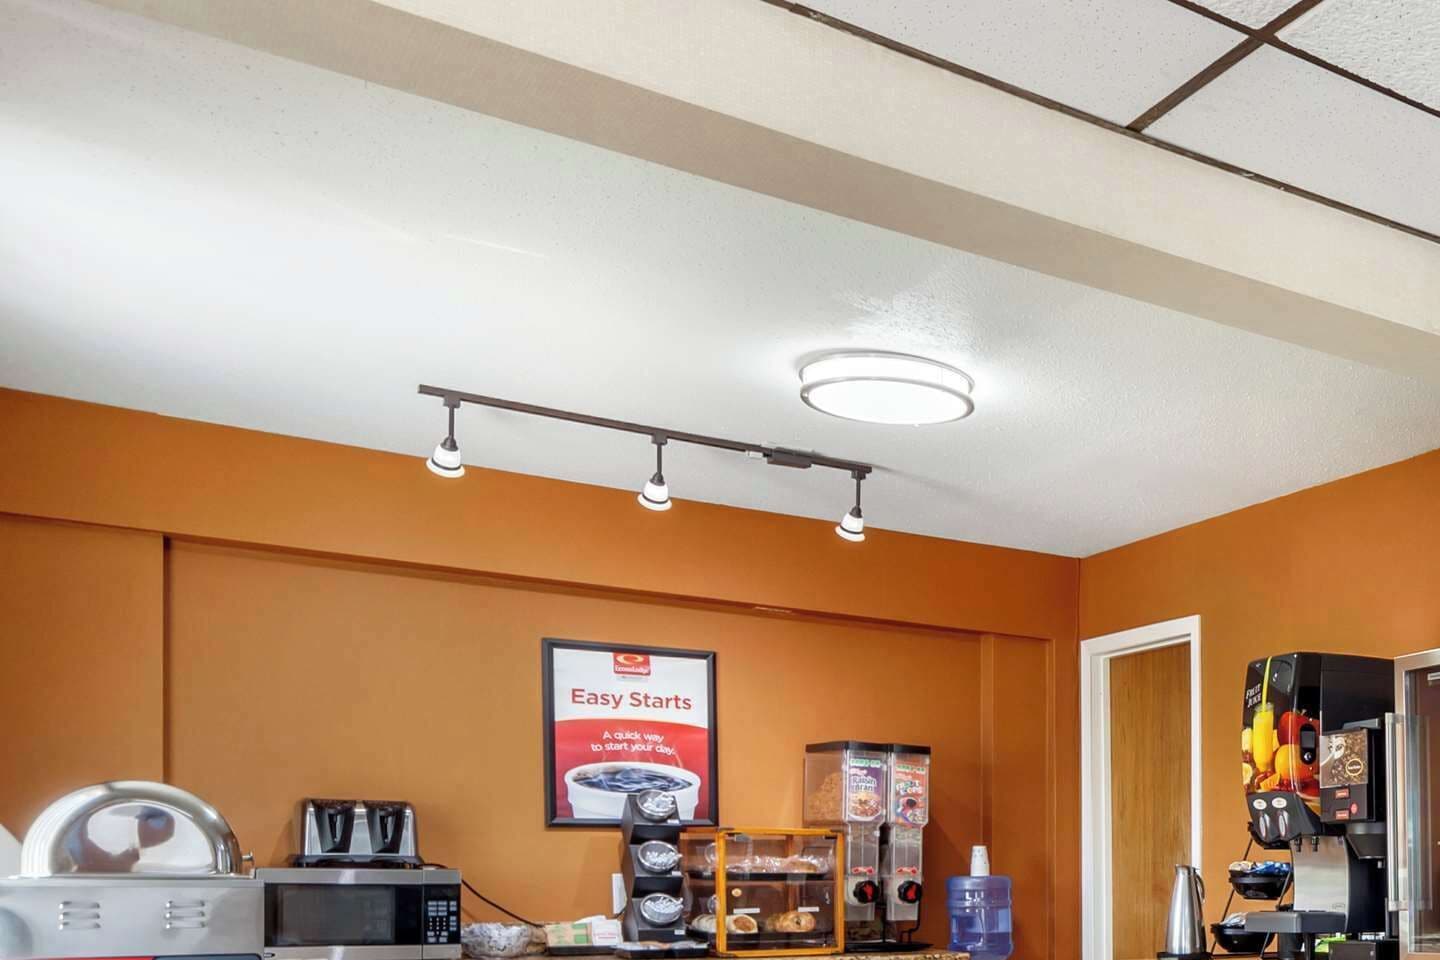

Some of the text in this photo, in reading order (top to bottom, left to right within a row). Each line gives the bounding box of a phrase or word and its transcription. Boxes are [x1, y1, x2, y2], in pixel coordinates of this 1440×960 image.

[571, 688, 692, 710] Easy Starts
[602, 730, 664, 744] A quick way
[590, 742, 676, 756] to start your day.
